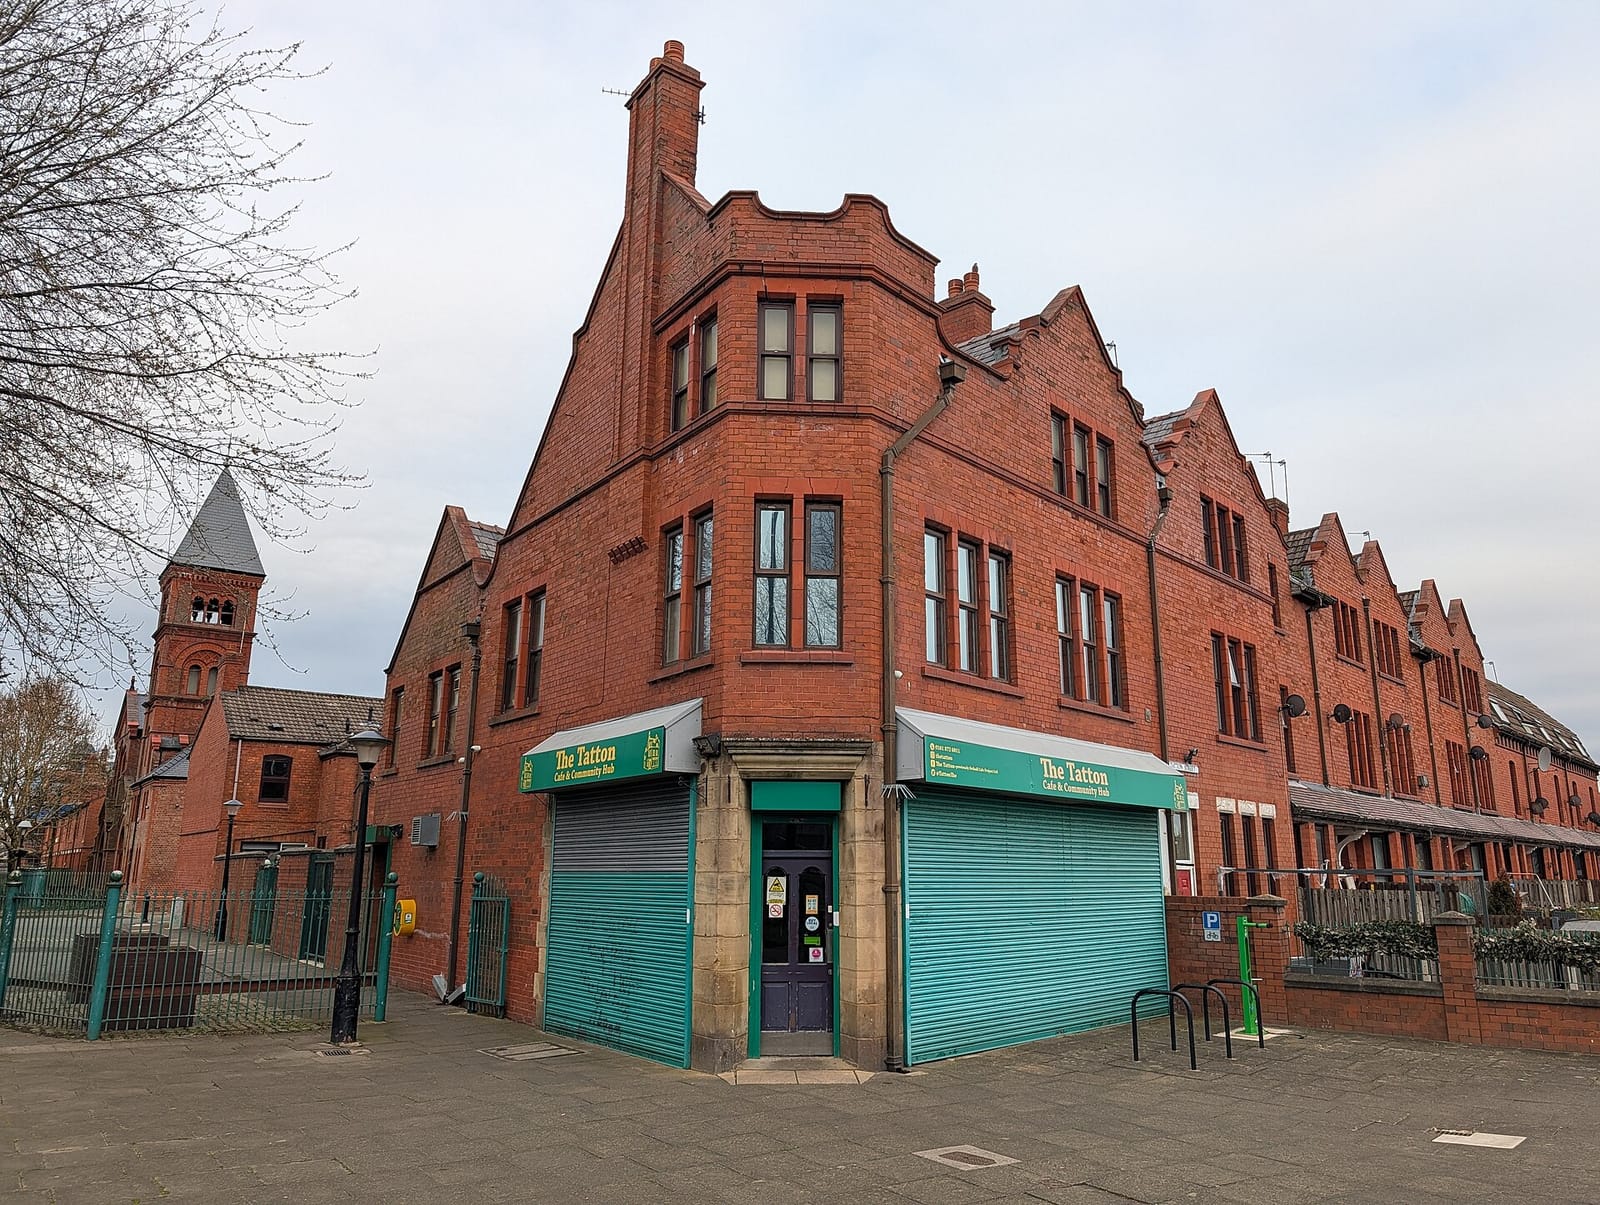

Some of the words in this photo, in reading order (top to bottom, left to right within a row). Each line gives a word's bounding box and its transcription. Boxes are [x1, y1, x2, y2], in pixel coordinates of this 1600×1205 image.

[556, 750, 574, 770] The
[577, 745, 616, 766] Tatton
[566, 771, 571, 780] &
[571, 766, 602, 779] Community
[602, 763, 615, 775] Hub
[1040, 757, 1065, 780] The
[1066, 761, 1109, 786] Tatton
[1042, 779, 1057, 791] Cafe
[1057, 781, 1064, 792] &
[1064, 782, 1097, 798] Community
[1097, 786, 1110, 797] Hub
[1206, 913, 1218, 928] P
